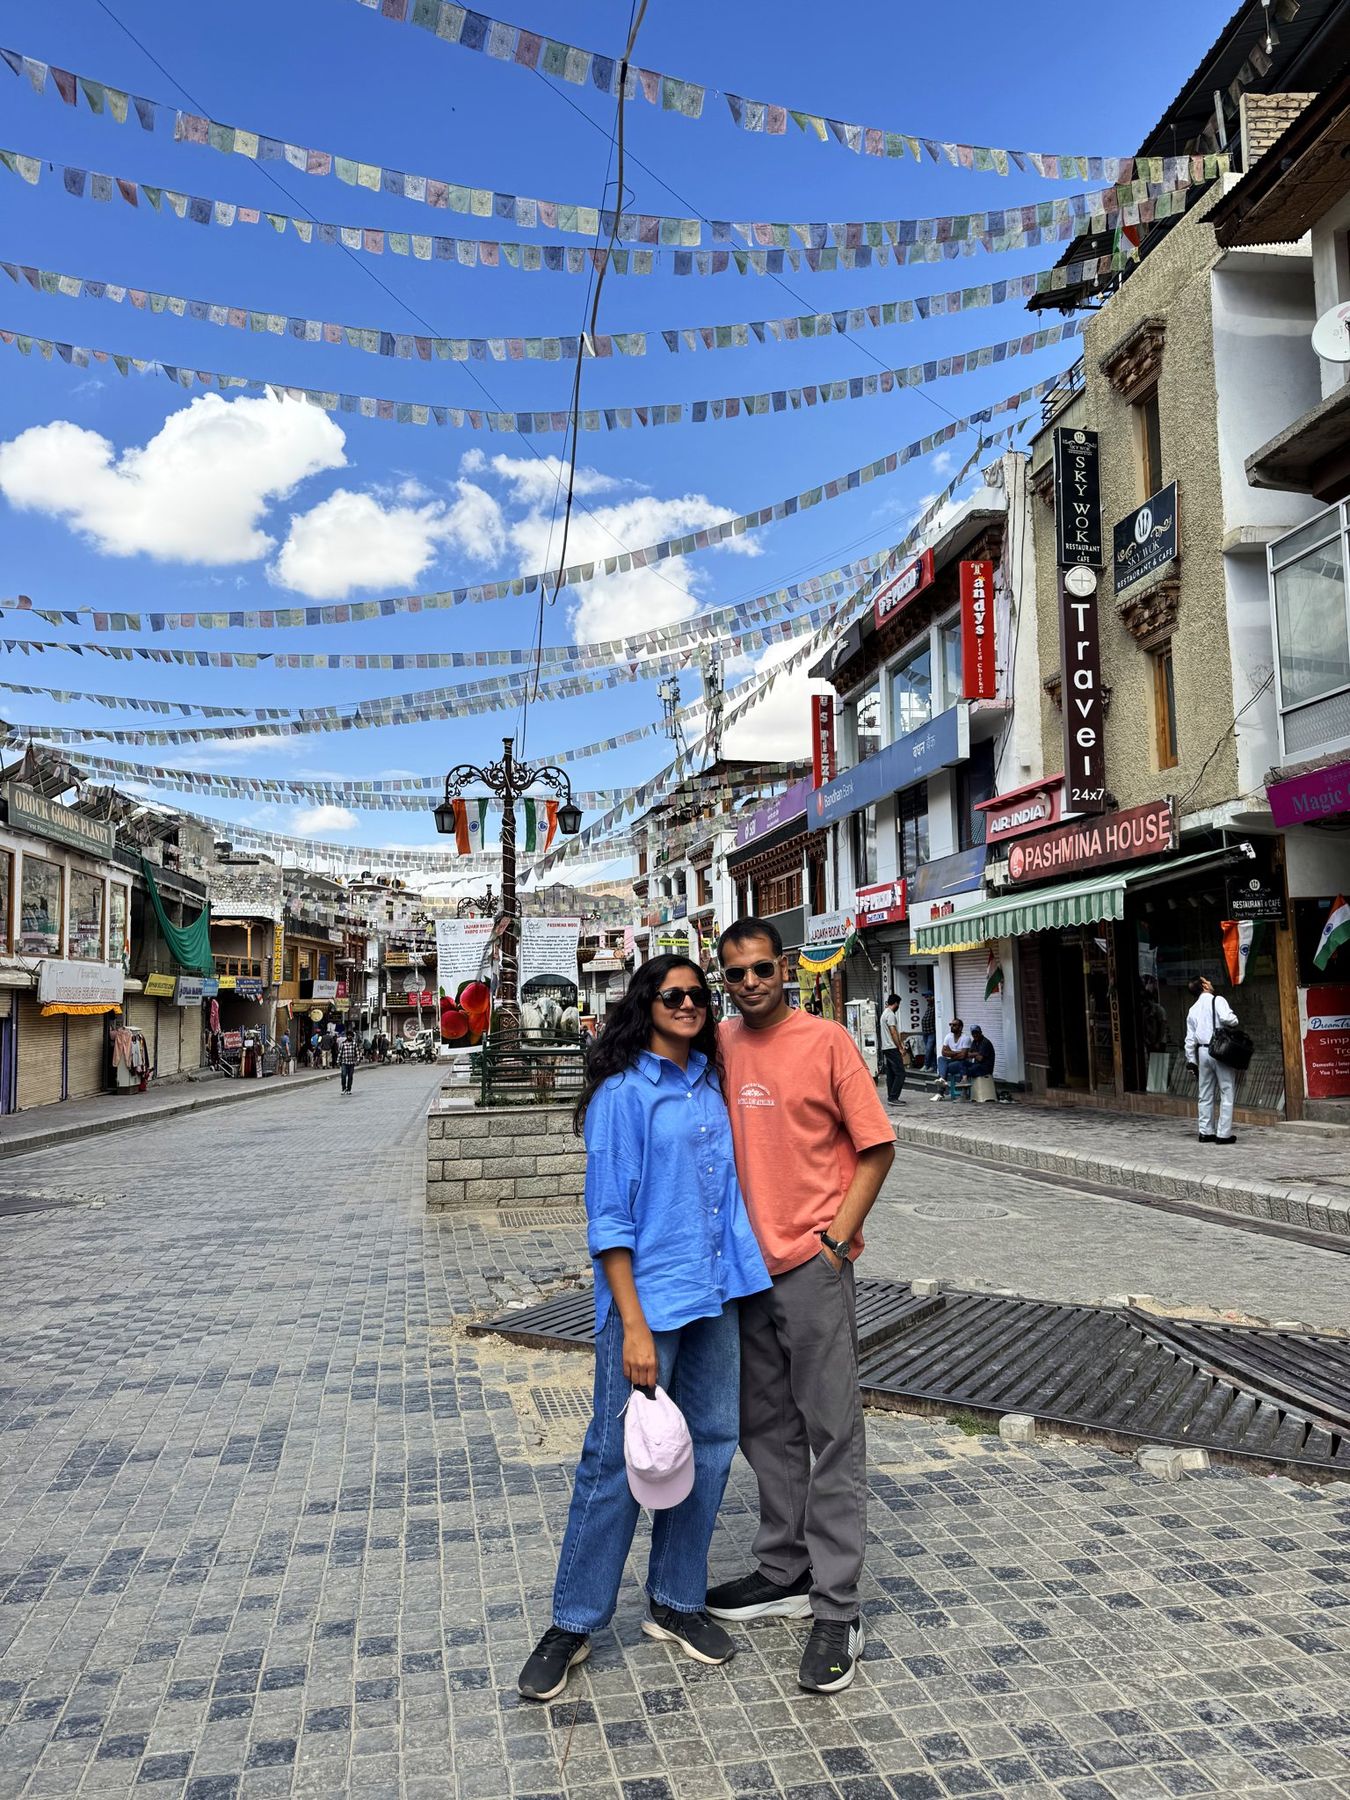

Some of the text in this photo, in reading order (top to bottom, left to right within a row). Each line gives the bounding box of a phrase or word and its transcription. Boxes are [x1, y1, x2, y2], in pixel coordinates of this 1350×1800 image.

[1074, 456, 1088, 497] SKY
[1073, 502, 1090, 543] WOK
[1065, 543, 1100, 553] RESTAURANT
[1128, 540, 1160, 567] SKY WOK
[1117, 561, 1151, 589] RESTAURANT
[1158, 547, 1173, 562] CAFE
[1070, 603, 1096, 777] Travel
[824, 788, 843, 808] Bandhan
[1071, 788, 1105, 802] 24x7
[1291, 786, 1343, 816] Magic
[14, 789, 49, 821] OROCK
[51, 804, 79, 833] GOODS
[80, 817, 109, 844] PLANET
[990, 804, 1045, 834] AIR INDIA
[1025, 808, 1170, 871] PASHMINA HOUSE
[1232, 899, 1264, 909] RESTAURANT
[273, 930, 283, 981] TERRACE
[910, 999, 920, 1030] SHOP
